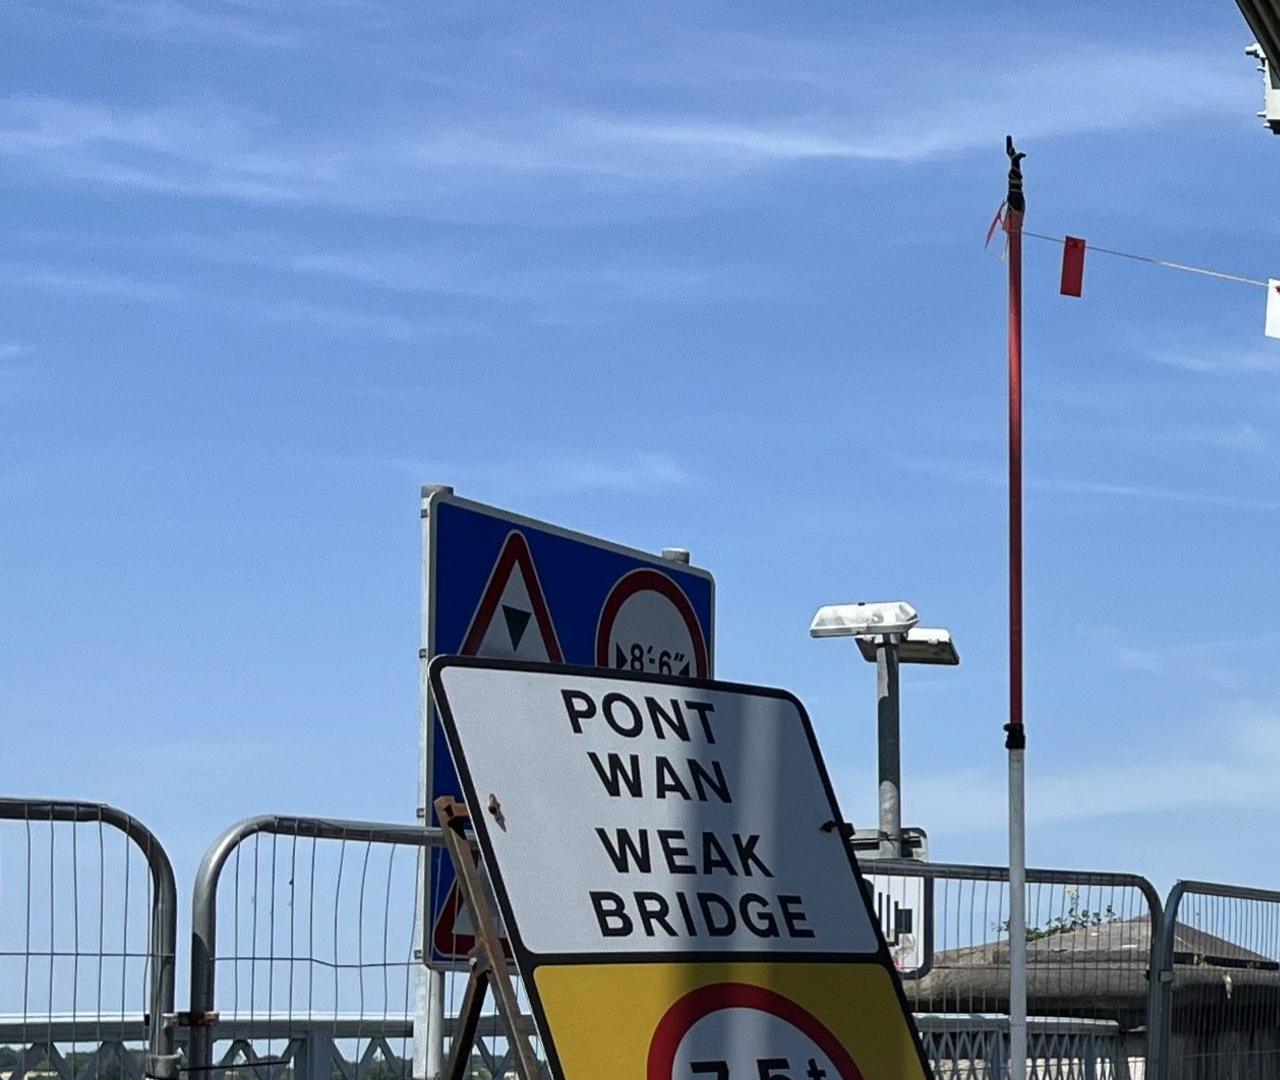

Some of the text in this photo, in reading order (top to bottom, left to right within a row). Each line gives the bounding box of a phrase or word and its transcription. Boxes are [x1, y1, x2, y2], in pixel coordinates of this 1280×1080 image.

[560, 688, 716, 745] PONT
[587, 751, 733, 804] WAN
[594, 826, 775, 879] WEAK
[589, 890, 817, 939] BRIDGE
